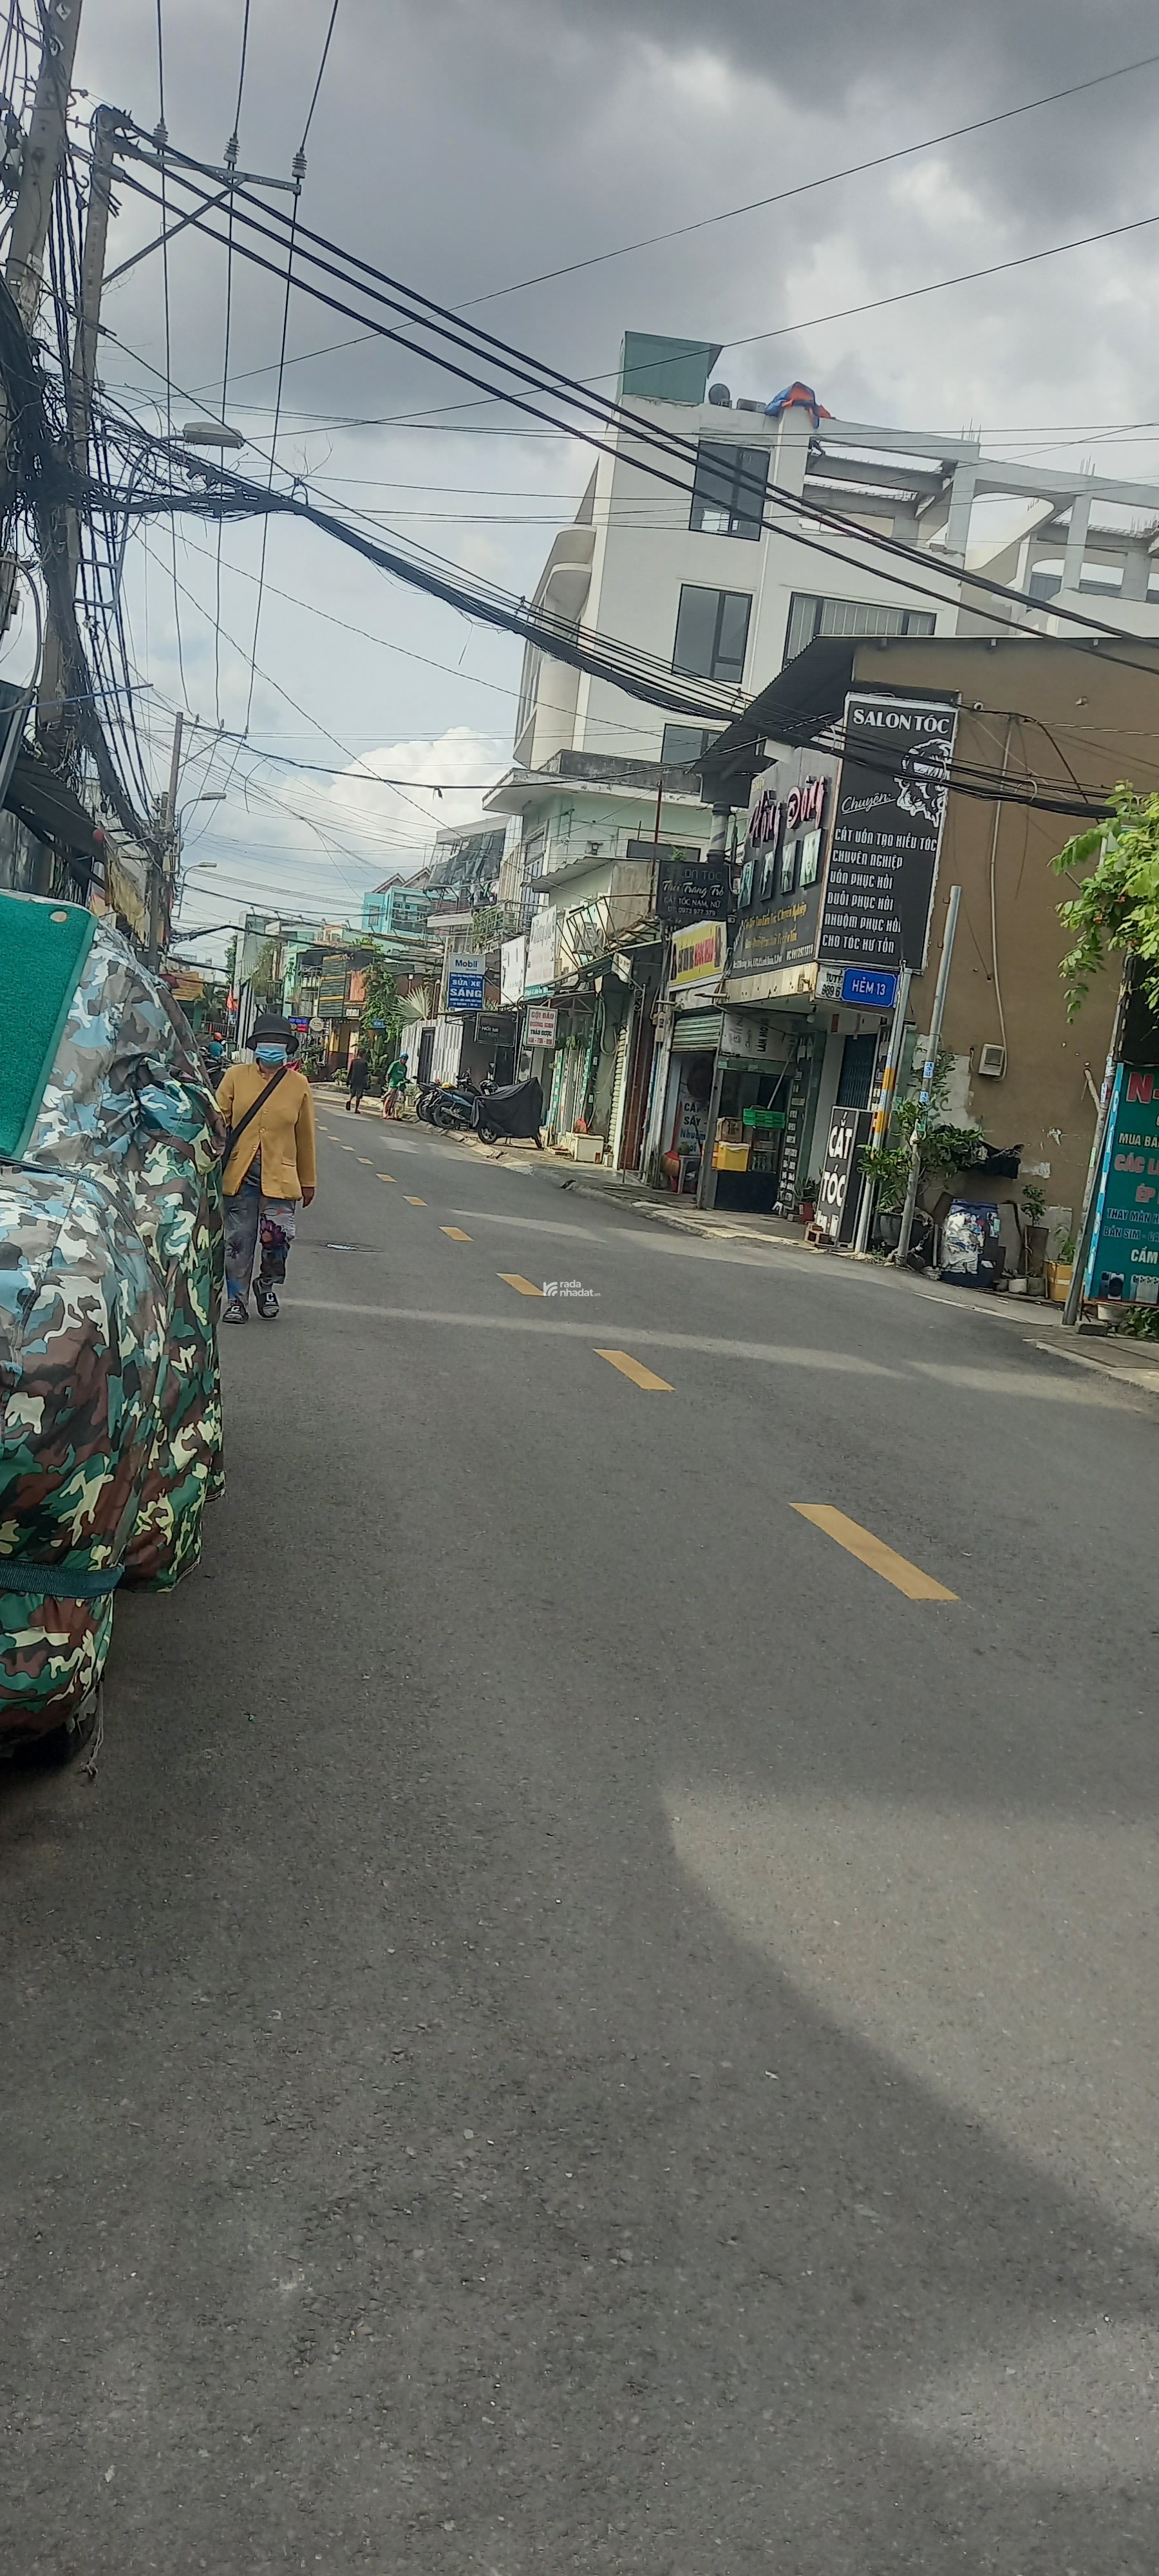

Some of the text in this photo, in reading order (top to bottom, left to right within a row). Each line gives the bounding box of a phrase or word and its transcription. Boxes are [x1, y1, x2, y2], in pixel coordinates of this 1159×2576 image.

[853, 709, 950, 734] SALON TÓC
[876, 832, 894, 848] TẠO
[919, 836, 938, 852] TÓC
[832, 849, 903, 871] CHUYÊN NGHIỆP
[683, 882, 707, 898] Trang
[850, 873, 875, 889] PHỤC
[851, 893, 876, 911] PHỤC
[824, 913, 858, 929] NHUỘM
[860, 916, 885, 933] PHỤC
[822, 934, 840, 948] CHO
[843, 935, 861, 950] TÓC
[862, 938, 876, 952] HƯ
[455, 959, 478, 968] Mobil
[452, 978, 469, 987] SỬA
[852, 976, 886, 996] HẺM 13
[449, 987, 482, 998] SÁNG
[828, 1112, 854, 1160] CẮT
[1118, 1133, 1159, 1148] MUA BÁ
[1114, 1151, 1146, 1174] CÁC
[822, 1164, 847, 1208] TÓC
[1107, 1208, 1129, 1220] THAY
[1124, 1229, 1142, 1240] SIM
